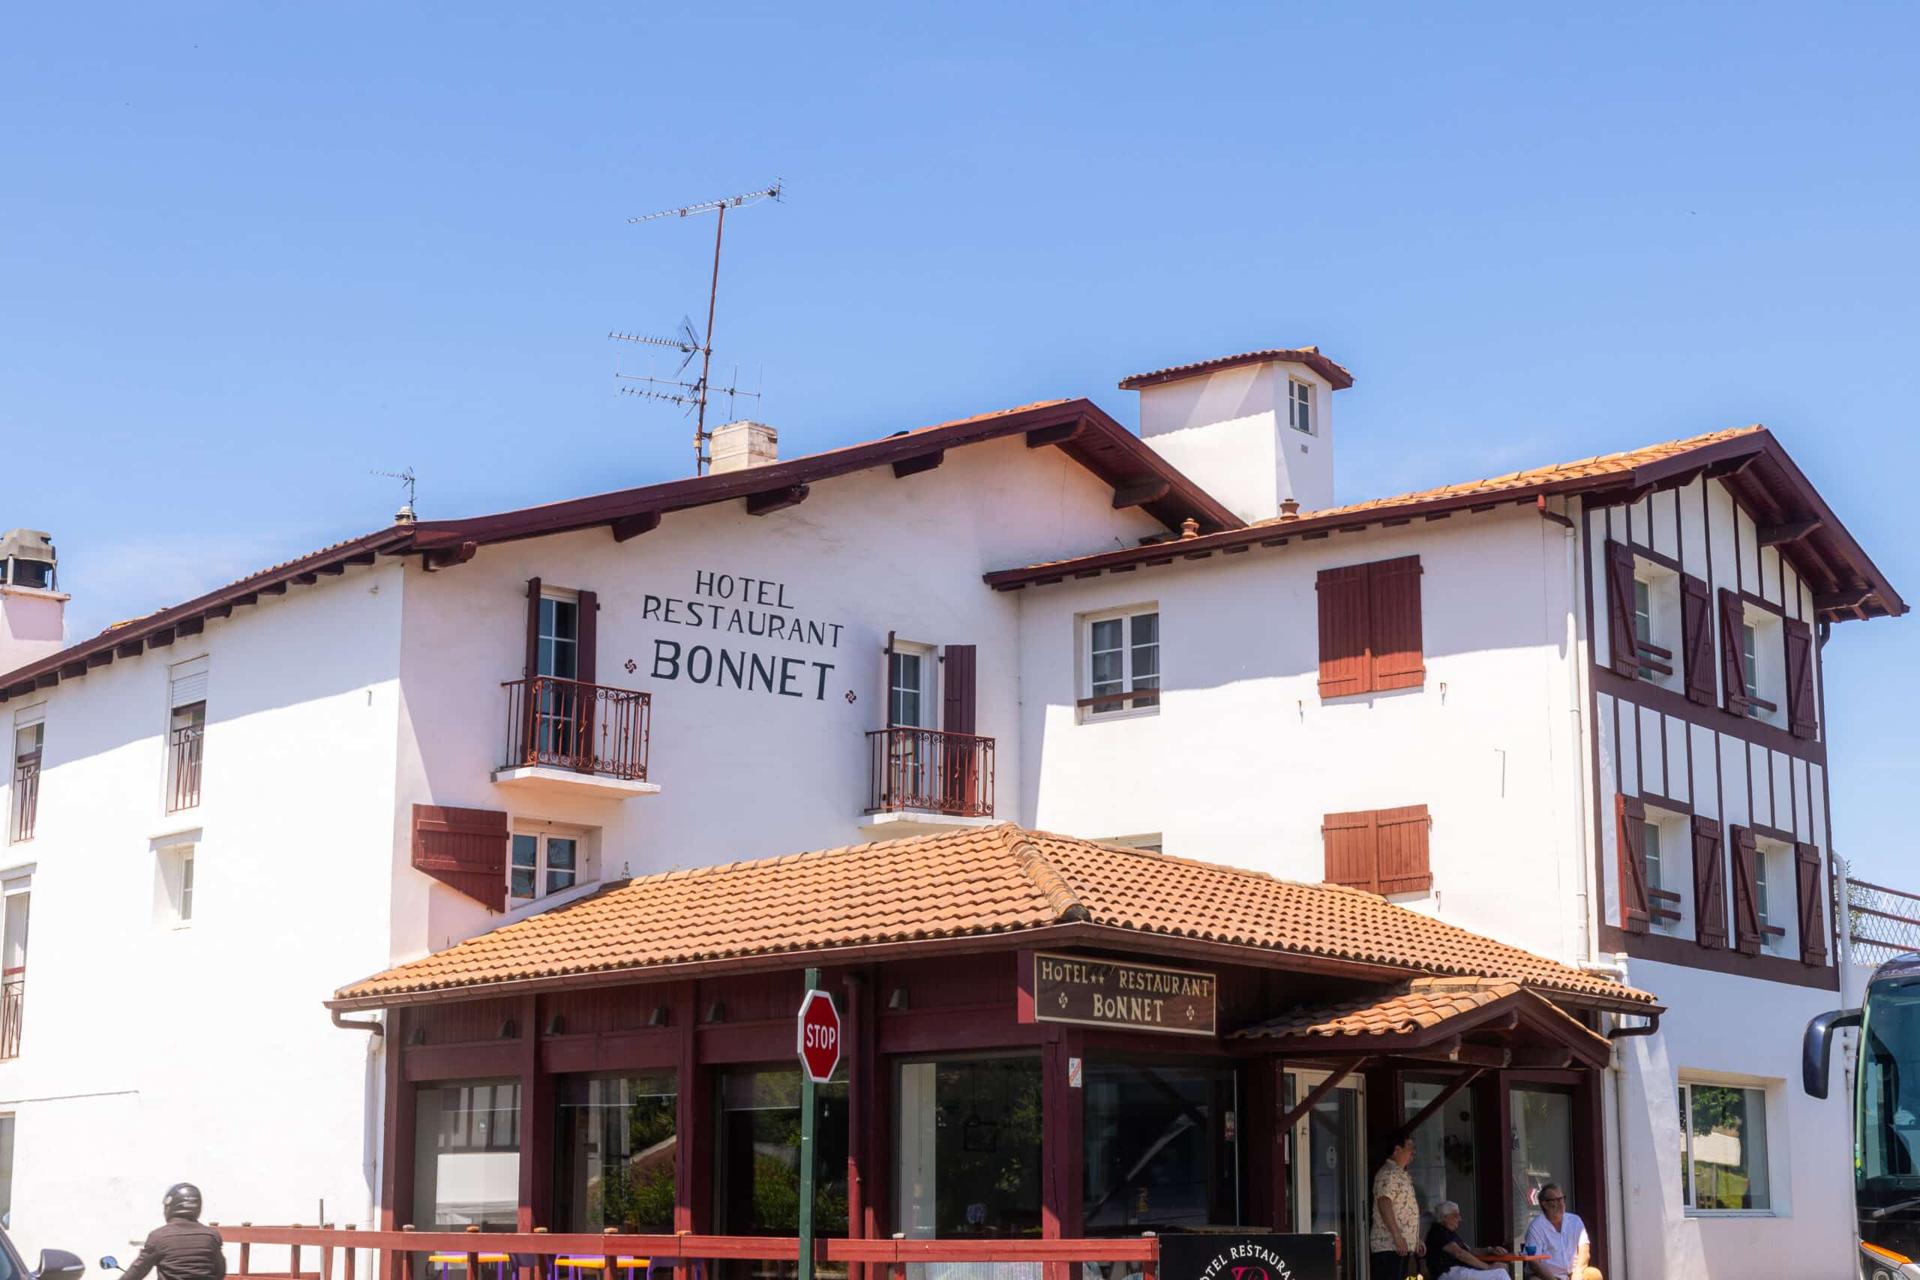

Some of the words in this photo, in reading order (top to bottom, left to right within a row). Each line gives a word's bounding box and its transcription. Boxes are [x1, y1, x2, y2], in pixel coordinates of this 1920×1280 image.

[695, 570, 794, 609] HOTEL
[642, 594, 844, 648] RESTAURANT
[651, 639, 835, 700] BONNET
[1119, 970, 1210, 997] RESTAURANT
[1093, 993, 1164, 1022] BONNET
[806, 1024, 836, 1050] STOP
[1230, 1244, 1295, 1280] RESTAURA
